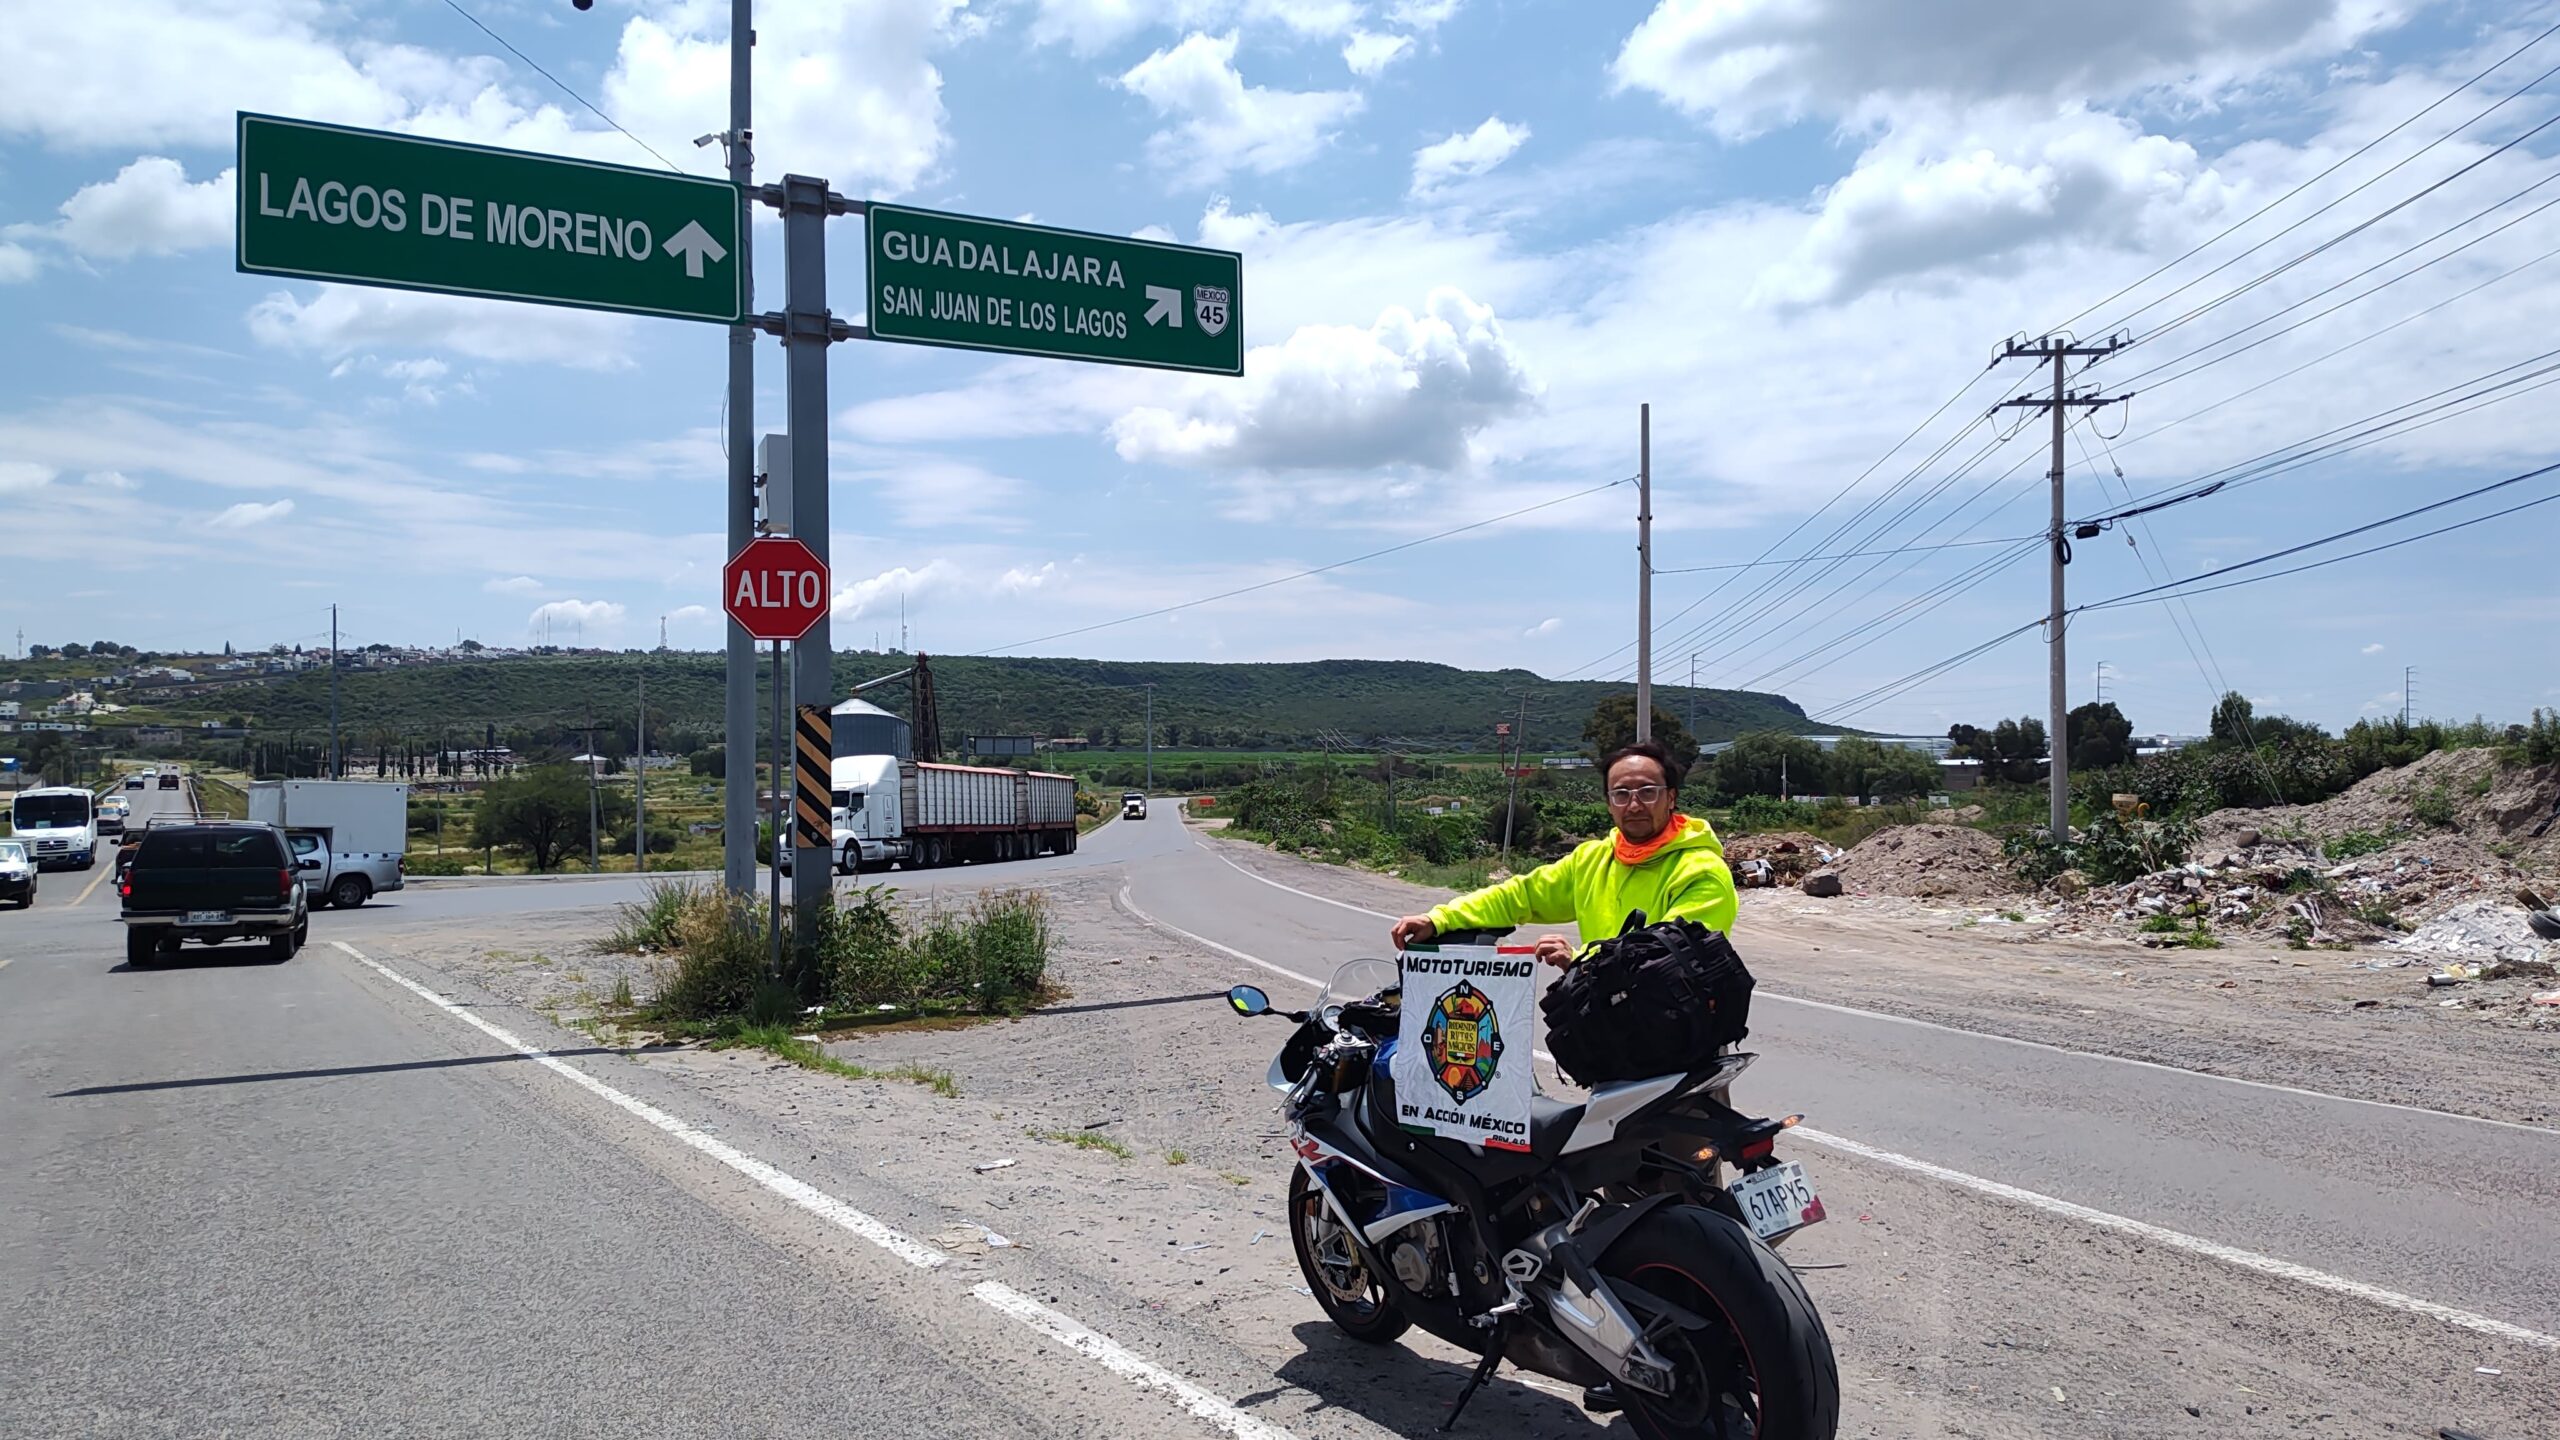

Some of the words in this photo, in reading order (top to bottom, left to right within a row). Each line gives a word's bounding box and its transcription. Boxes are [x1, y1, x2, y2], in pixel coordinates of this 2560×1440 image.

[259, 171, 408, 232] LAGOS
[420, 193, 475, 241] DE
[485, 201, 653, 262] MORENO
[882, 230, 1126, 289] GUADALAJARA
[882, 284, 924, 318] SAN
[930, 290, 981, 324] JUAN
[987, 296, 1013, 327] DE
[1019, 301, 1057, 332] LOS
[1063, 307, 1128, 340] LAGOS
[1199, 305, 1225, 325] 45
[733, 569, 821, 609] ALTO
[1406, 956, 1534, 978] MOTOTURISMO
[1459, 984, 1469, 995] N
[1493, 1041, 1501, 1052] E
[1456, 1090, 1464, 1100] S
[1401, 1104, 1419, 1118] EN
[1423, 1107, 1466, 1126] ACCIÓN
[1469, 1112, 1526, 1135] MÉXICO
[1749, 1178, 1811, 1221] 67APX5
